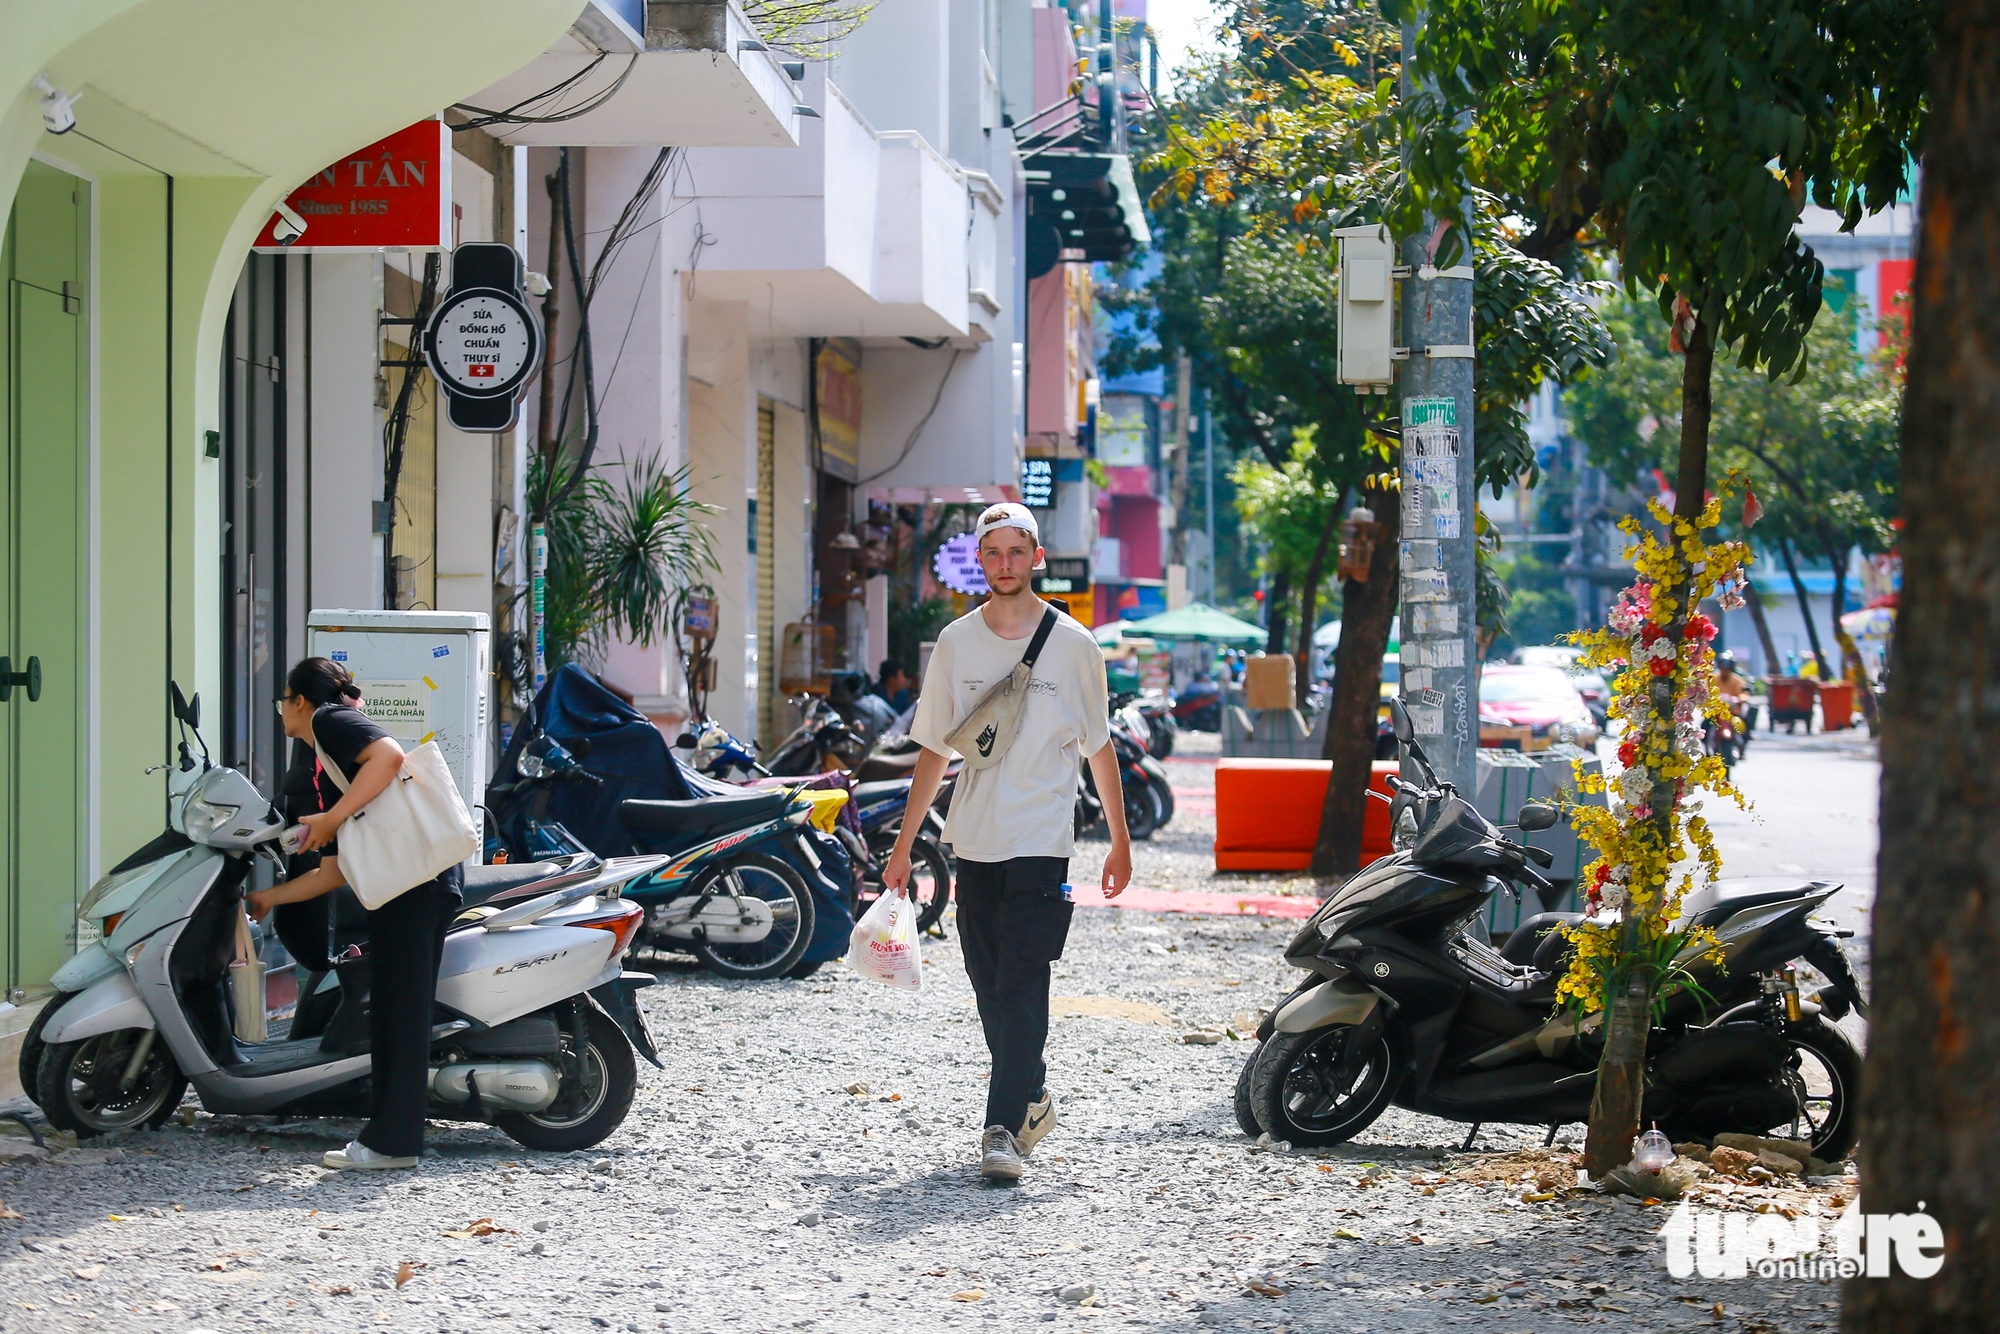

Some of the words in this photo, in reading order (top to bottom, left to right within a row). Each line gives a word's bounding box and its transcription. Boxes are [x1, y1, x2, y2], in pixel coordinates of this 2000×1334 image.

[302, 163, 337, 187] N
[349, 152, 427, 187] TÂN
[297, 200, 344, 215] Since
[349, 199, 389, 215] 1985
[473, 308, 493, 319] SỬA
[373, 697, 391, 706] BẢO
[393, 697, 418, 707] QUẢN
[367, 707, 385, 716] SẢN
[386, 707, 399, 716] CÁ
[400, 707, 425, 717] NHÂN
[975, 724, 996, 749] NIKE
[505, 1083, 539, 1092] HONDA
